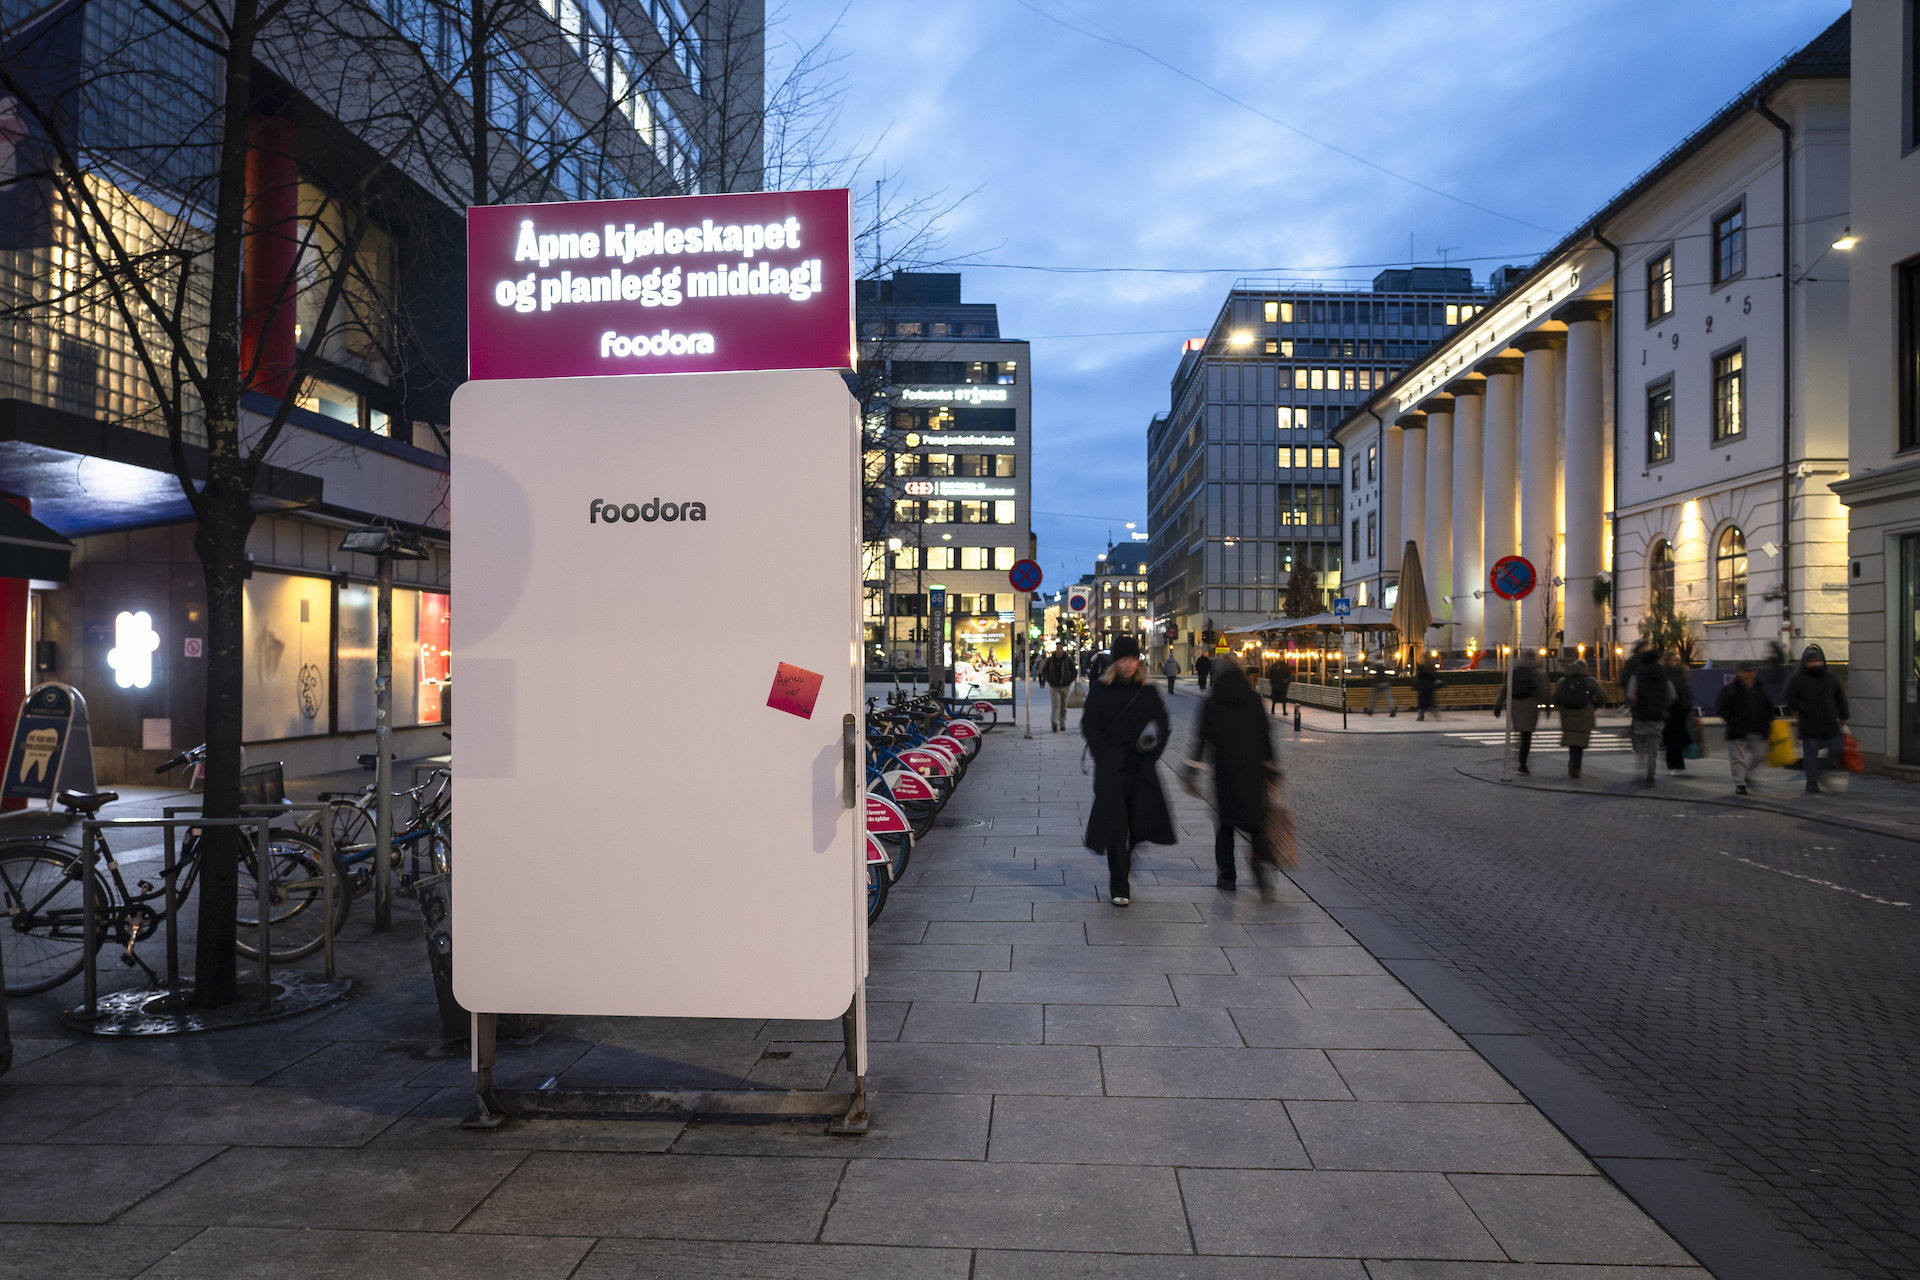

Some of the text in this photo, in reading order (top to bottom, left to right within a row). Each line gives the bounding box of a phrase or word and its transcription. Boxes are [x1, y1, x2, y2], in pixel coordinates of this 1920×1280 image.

[515, 216, 801, 267] Åpne kjøleskapet
[495, 260, 822, 312] og planlegg middag!
[601, 329, 714, 358] foodora
[590, 497, 706, 524] foodora
